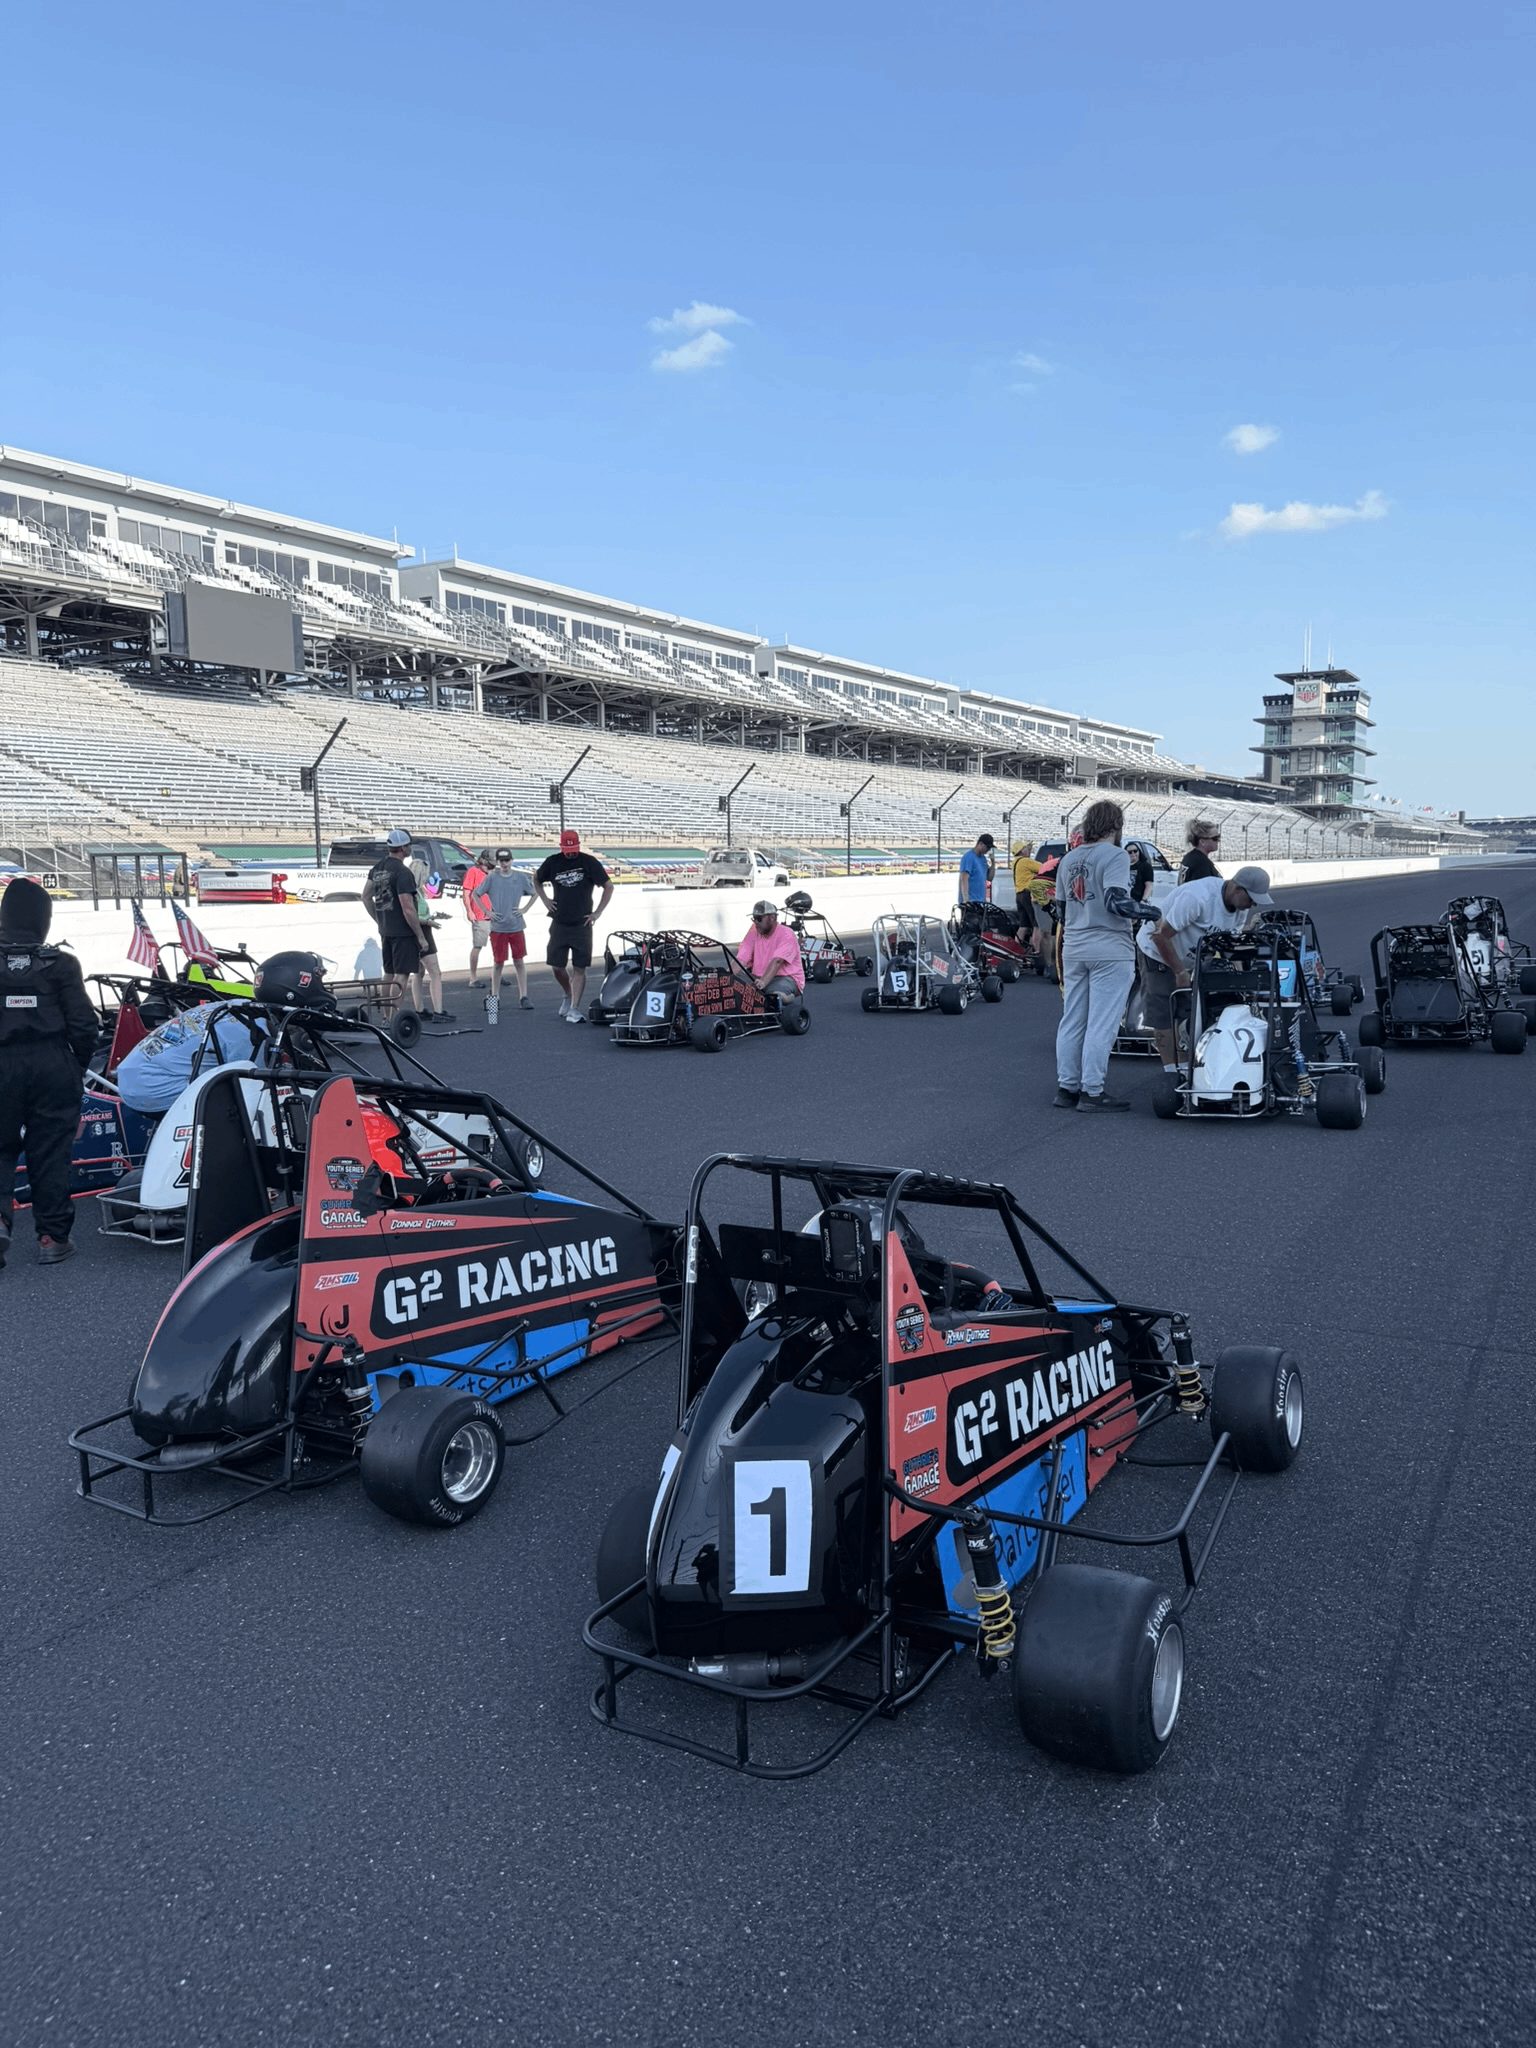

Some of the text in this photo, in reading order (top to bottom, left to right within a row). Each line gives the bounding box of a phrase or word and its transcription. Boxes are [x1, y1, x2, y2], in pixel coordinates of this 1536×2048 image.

[1299, 684, 1317, 692] TAG
[1471, 949, 1485, 966] 51
[896, 974, 906, 989] 5
[707, 988, 720, 1000] DEB
[651, 997, 661, 1013] 3
[1234, 1028, 1262, 1063] 2
[80, 1112, 113, 1121] AMERICANS
[391, 1218, 456, 1230] CONNOR GUTHRIE
[457, 1236, 618, 1309] RACING
[315, 1273, 359, 1290] AMSOIL
[896, 1313, 924, 1329] YOUTH SERIES
[945, 1328, 990, 1345] RYAN GUTHRIE
[1005, 1339, 1116, 1442] RACING
[904, 1406, 936, 1432] AMSOIL
[904, 1462, 940, 1494] GARAGE
[750, 1487, 787, 1577] 1
